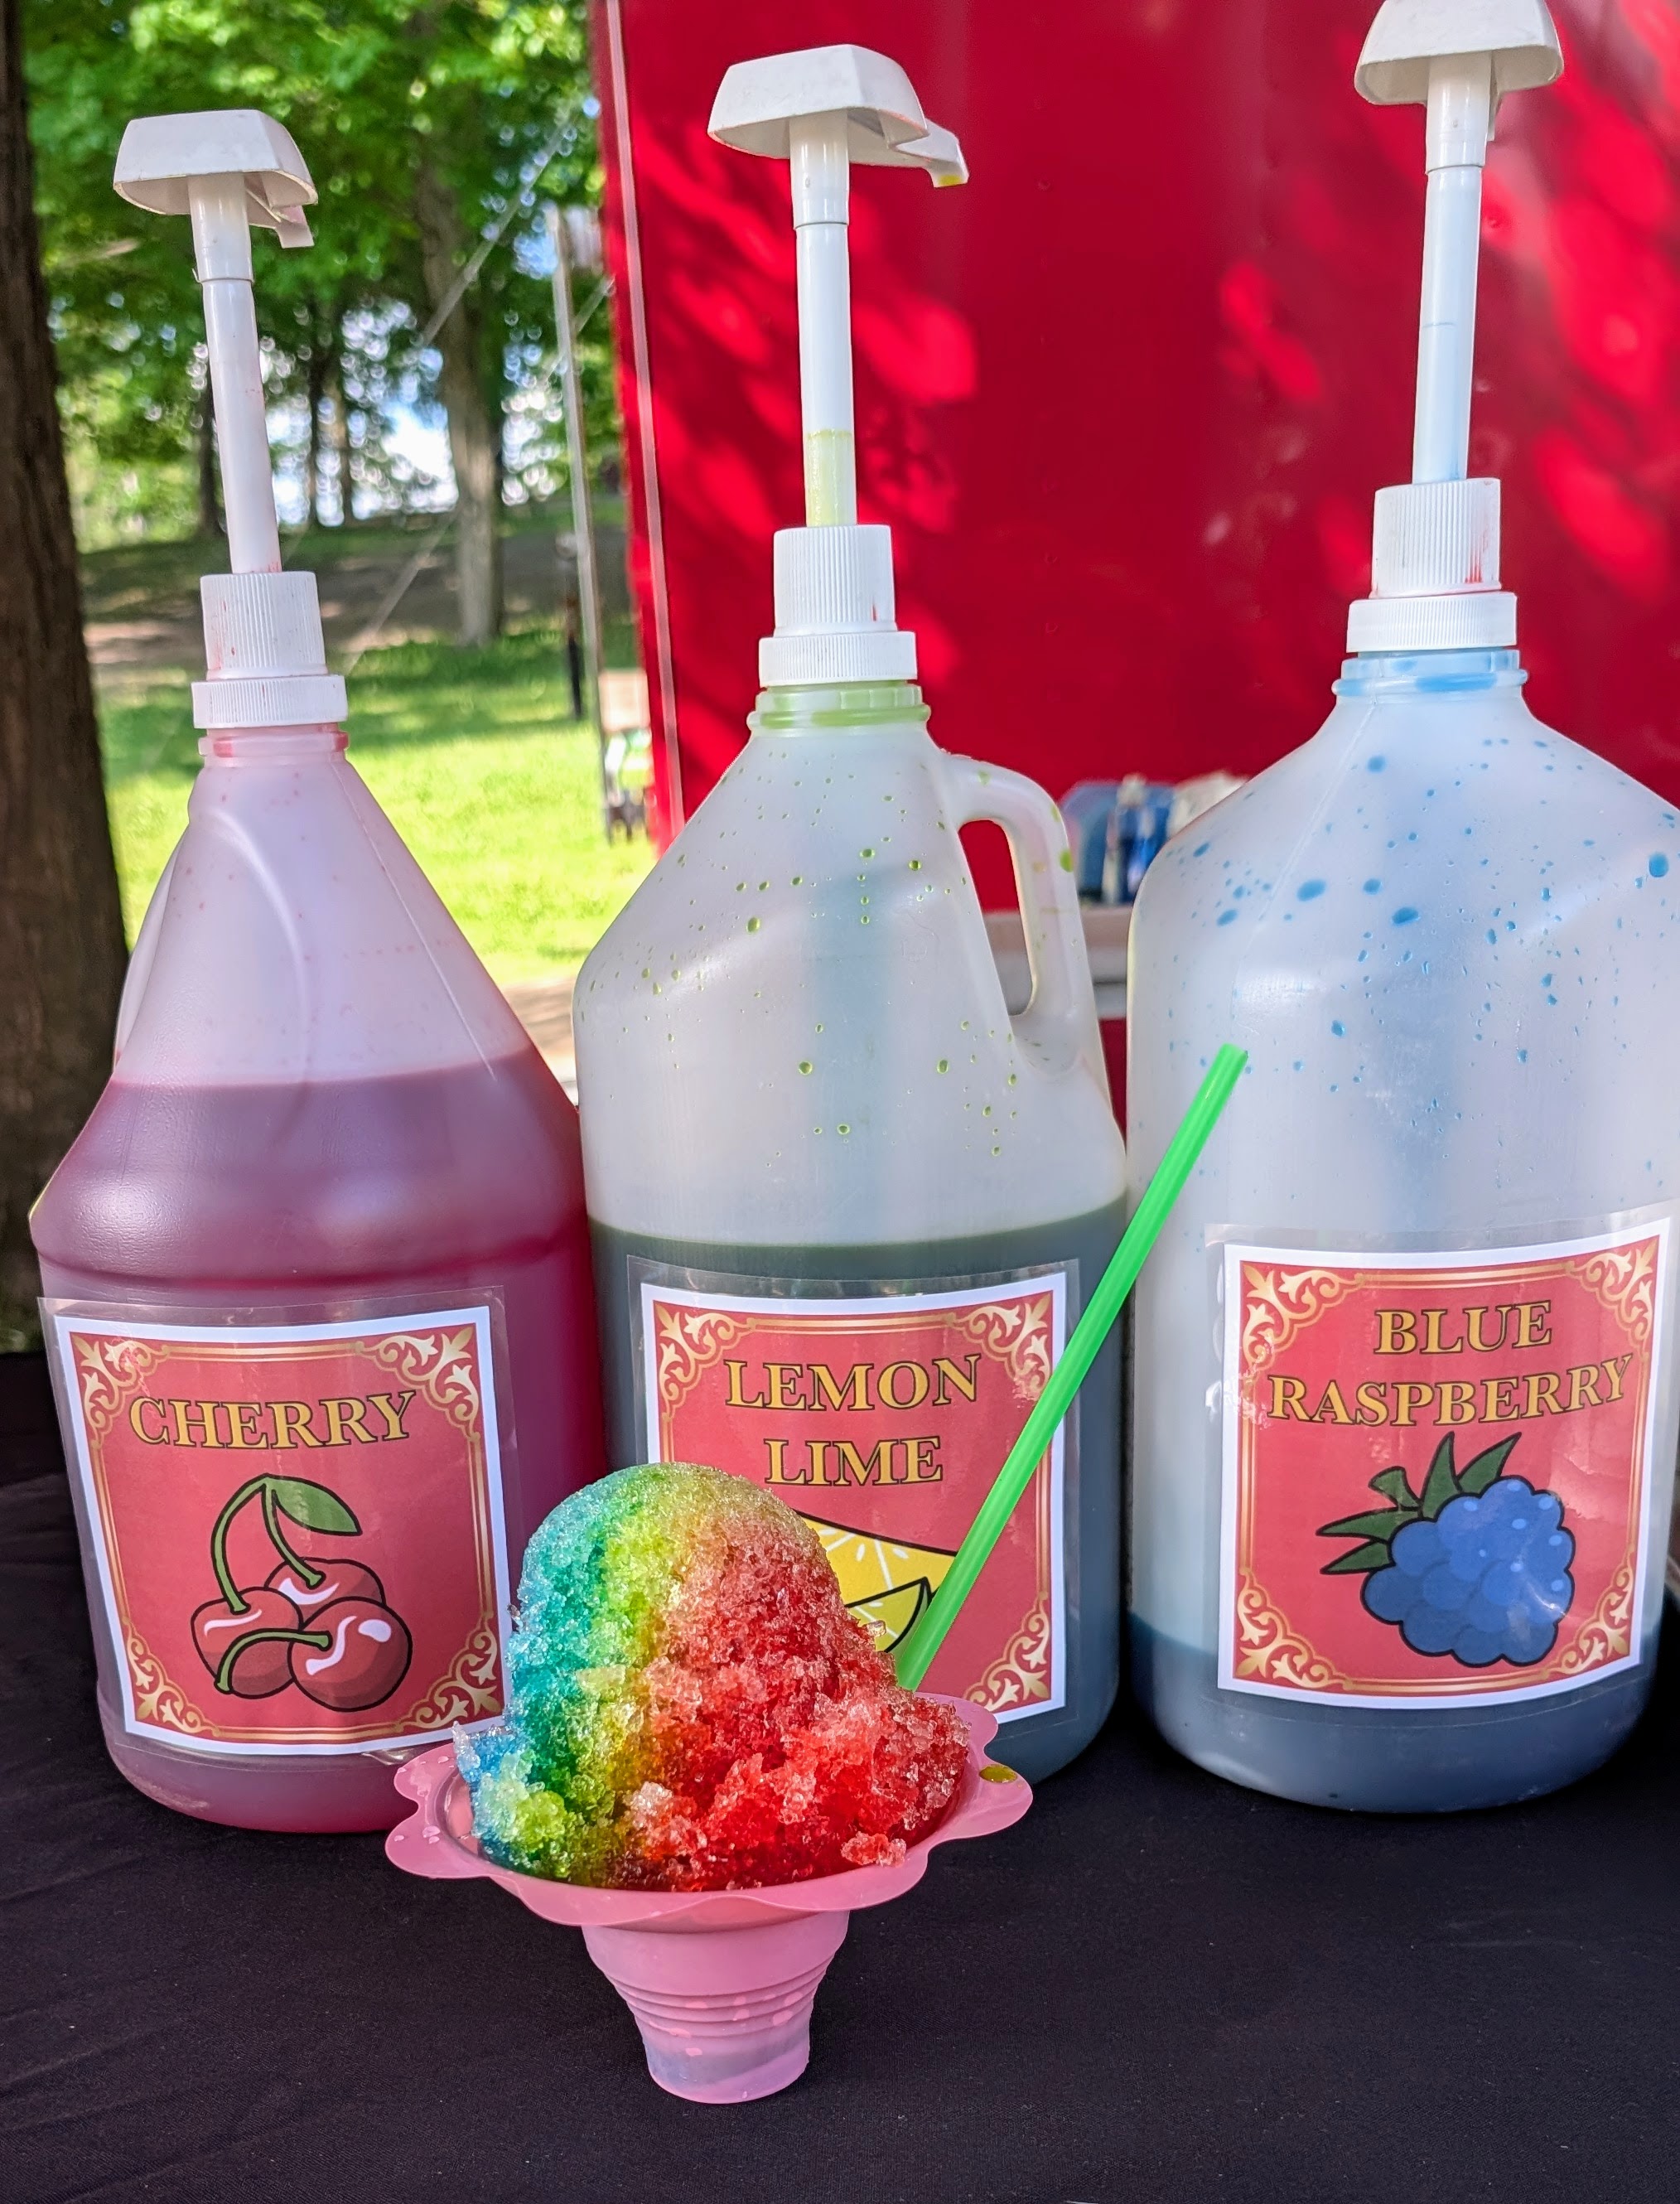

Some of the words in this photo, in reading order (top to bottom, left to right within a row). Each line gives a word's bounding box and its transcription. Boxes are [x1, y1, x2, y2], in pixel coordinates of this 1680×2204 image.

[1374, 1299, 1552, 1355] BLUE
[723, 1353, 982, 1411] LEMON
[1267, 1354, 1633, 1427] RASPBERRY
[129, 1390, 416, 1450] CHERRY
[764, 1435, 944, 1486] LIME
